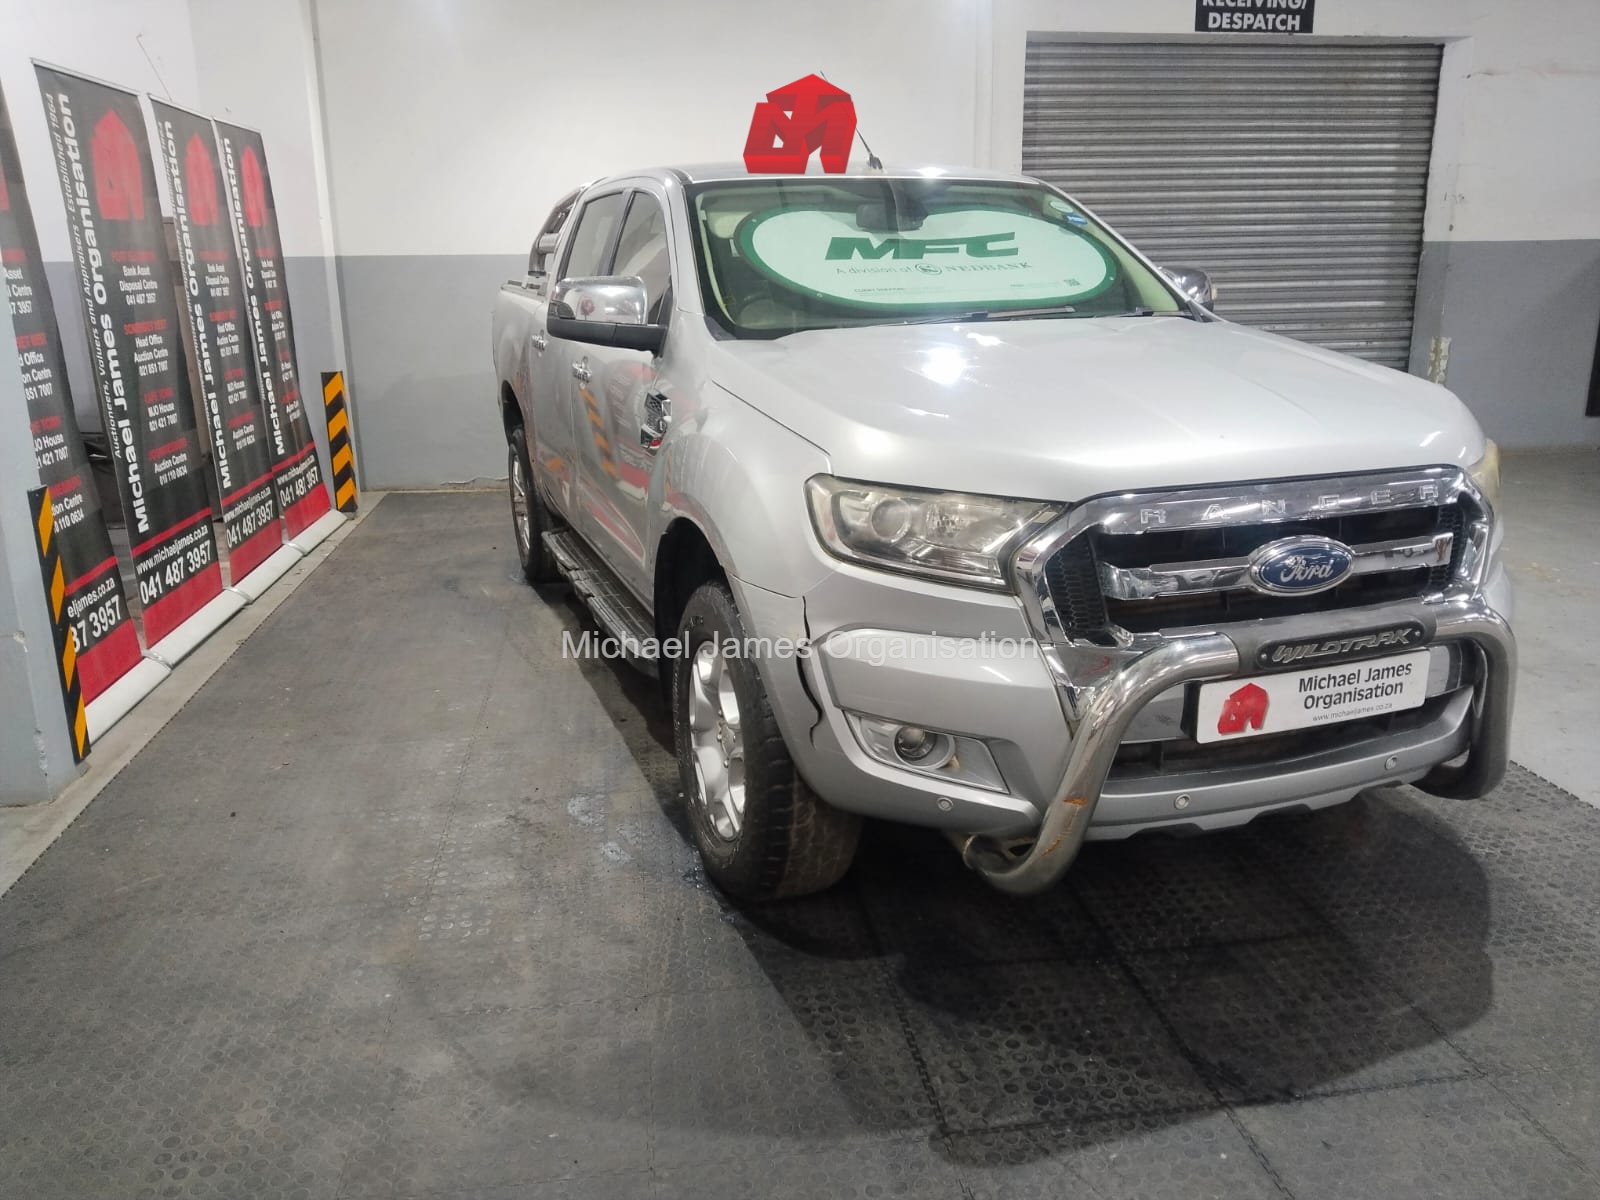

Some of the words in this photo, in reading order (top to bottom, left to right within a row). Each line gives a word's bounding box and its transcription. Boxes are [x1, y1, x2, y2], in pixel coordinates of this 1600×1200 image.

[1208, 12, 1301, 31] DESPATCH
[55, 131, 76, 213] Established
[58, 93, 108, 306] Organisation
[165, 120, 199, 296] Organisation
[73, 222, 91, 297] Appraisers
[825, 231, 1019, 261] MFC
[945, 261, 1033, 273] NEDBANK
[85, 298, 97, 325] and
[250, 294, 269, 367] James
[24, 351, 45, 366] Office
[92, 327, 106, 376] Valuers
[100, 313, 128, 411] James
[194, 303, 214, 386] James
[262, 371, 286, 456] Michael
[42, 432, 64, 450] House
[207, 391, 232, 490] Michael
[117, 419, 149, 534] Michael
[279, 484, 295, 508] 041
[226, 526, 244, 550] 041
[243, 514, 257, 538] 487
[255, 500, 274, 527] 3957
[1140, 484, 1440, 525] RANGER
[135, 523, 209, 576] www.michaeljames.co.za
[139, 573, 163, 605] 041
[165, 557, 186, 589] 487
[187, 539, 212, 574] 3957
[1279, 554, 1335, 583] Ford
[89, 593, 122, 639] 3957
[1272, 628, 1413, 664] WILDTRAK
[1298, 669, 1361, 693] Michael
[1364, 662, 1413, 683] James
[1303, 681, 1404, 710] Organisation
